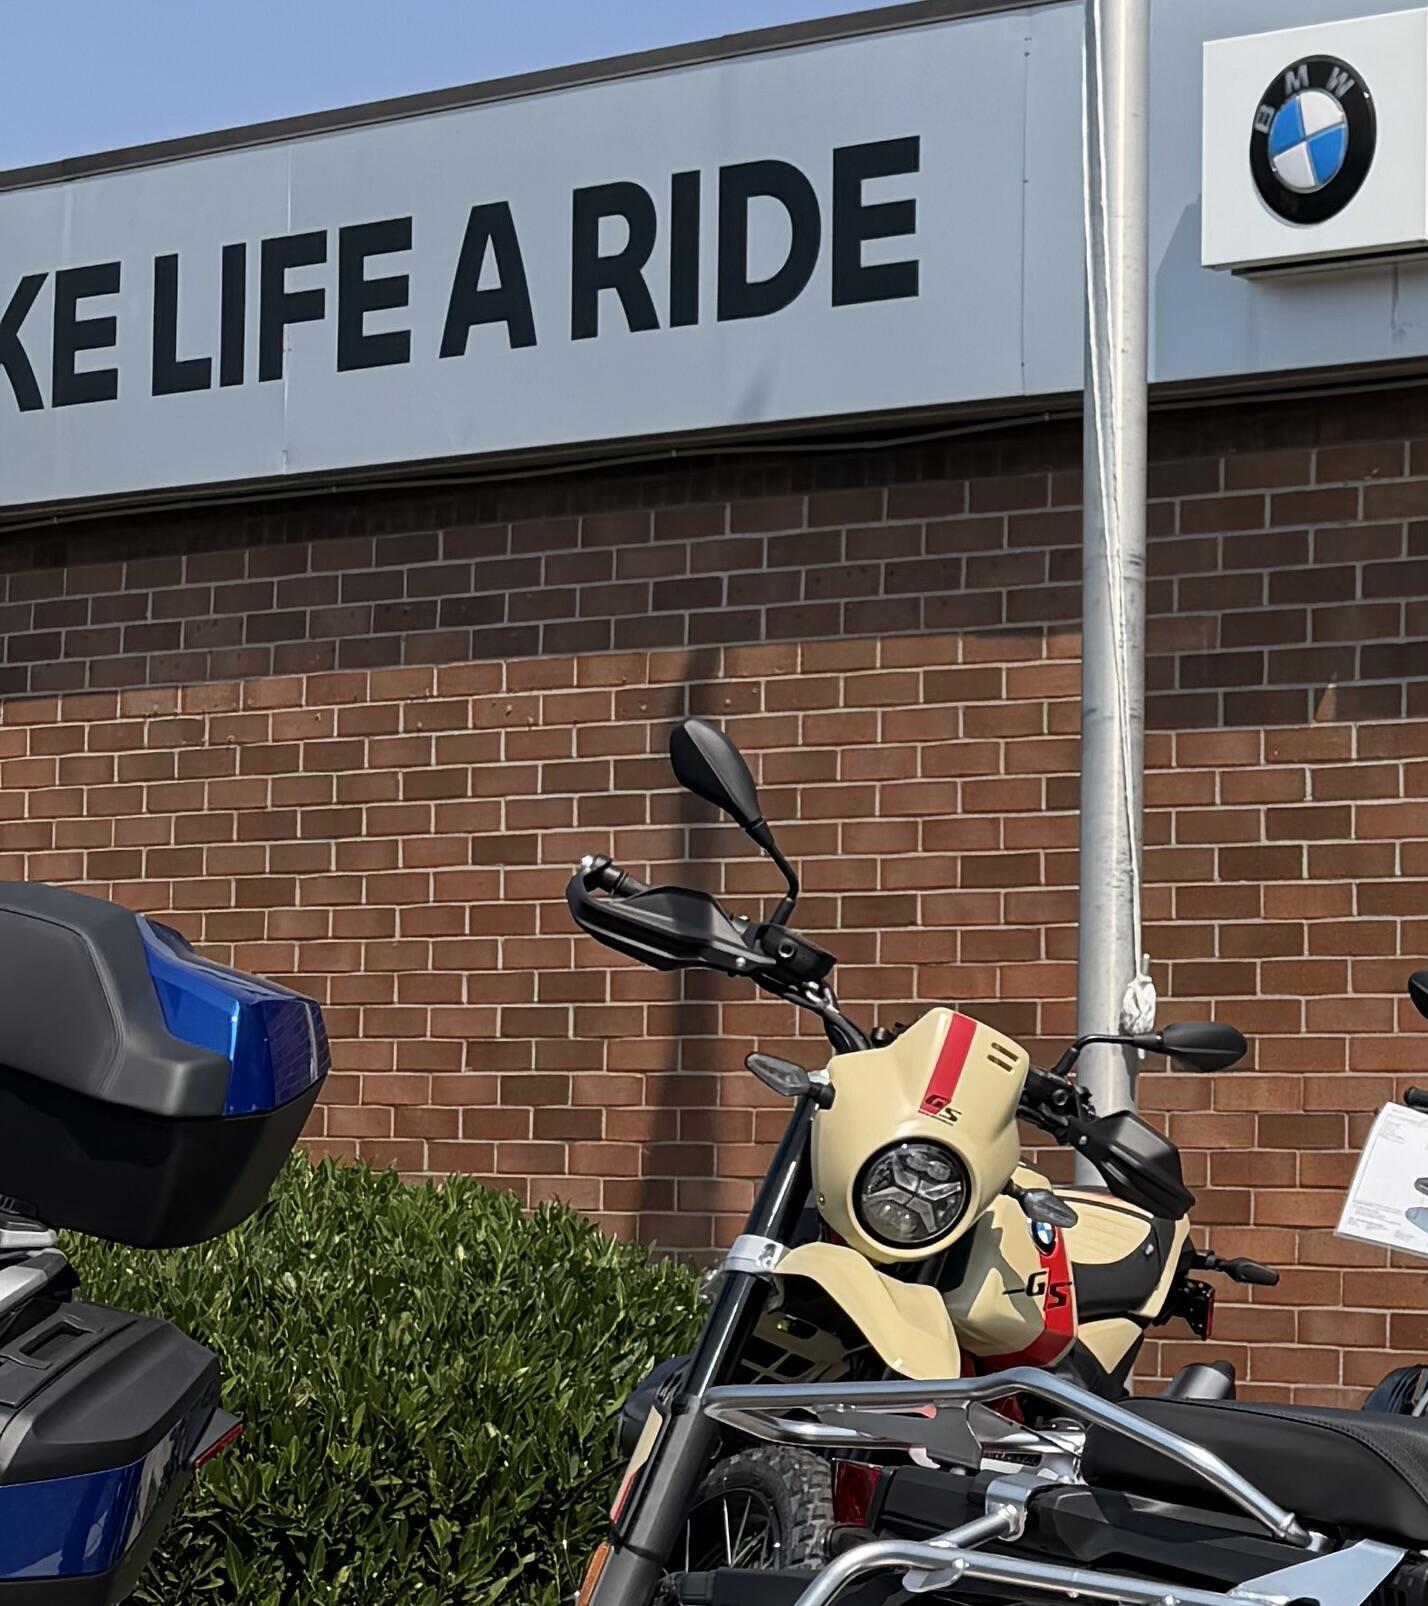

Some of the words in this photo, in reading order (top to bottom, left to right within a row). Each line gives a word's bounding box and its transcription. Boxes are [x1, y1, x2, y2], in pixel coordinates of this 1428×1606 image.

[152, 216, 413, 397] LIFE
[439, 201, 538, 359] A
[571, 135, 921, 341] RIDE
[925, 1094, 963, 1122] GS
[1026, 1271, 1073, 1310] GS
